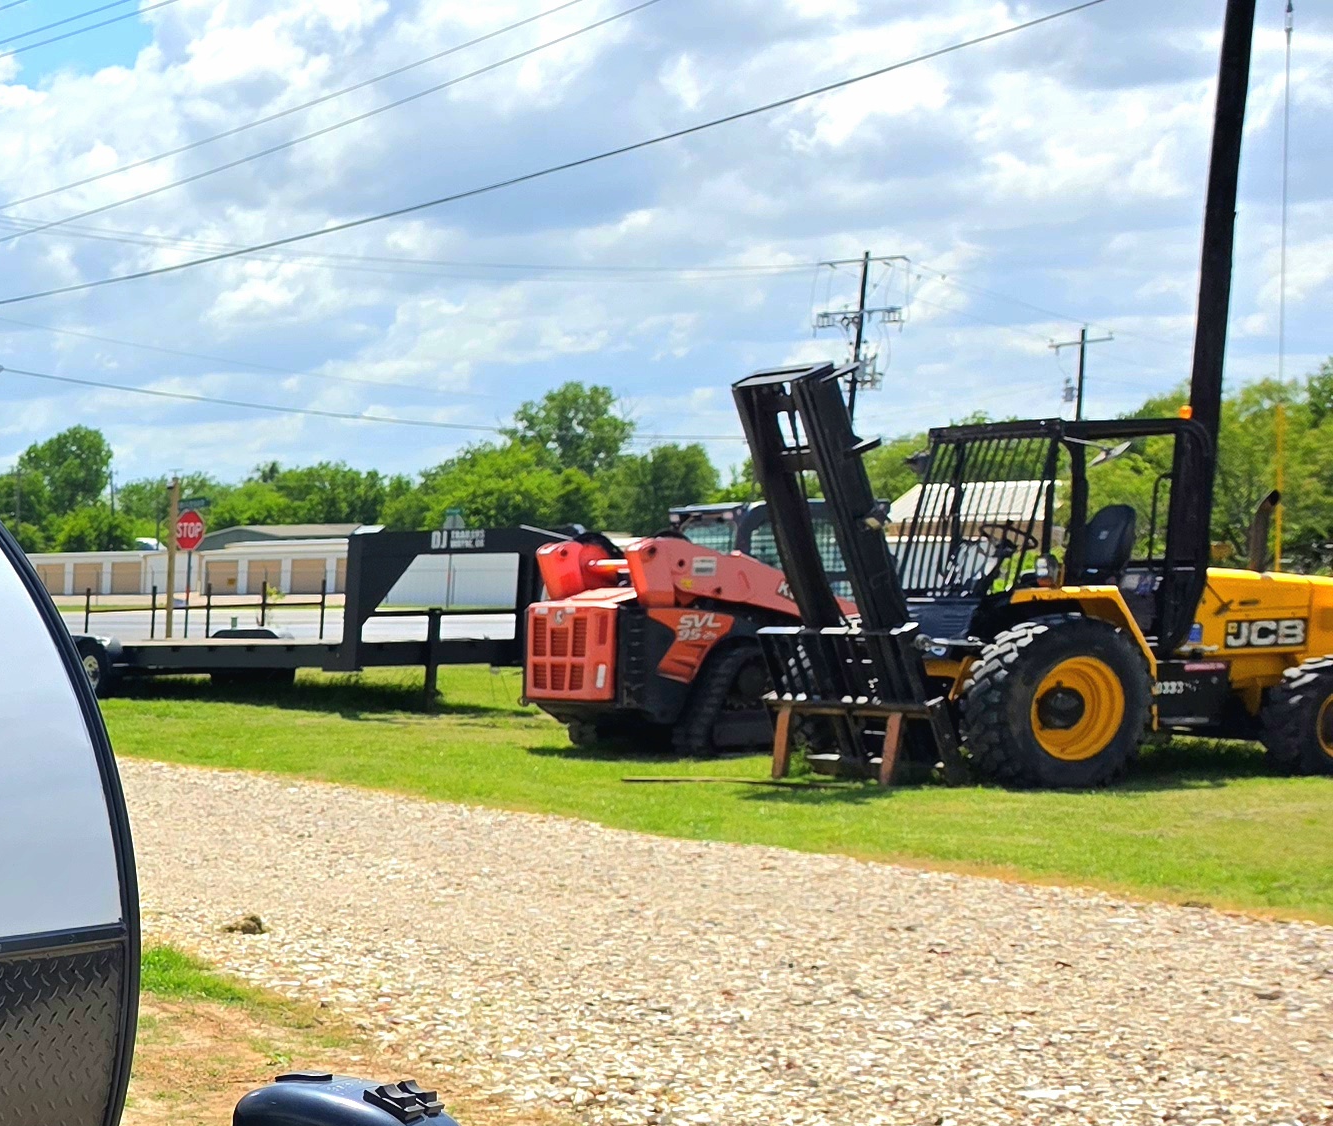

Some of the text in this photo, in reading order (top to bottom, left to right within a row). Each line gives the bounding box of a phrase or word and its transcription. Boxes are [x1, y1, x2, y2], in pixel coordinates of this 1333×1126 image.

[176, 522, 202, 538] STOP
[677, 613, 722, 629] SVL
[1226, 619, 1305, 647] JCB
